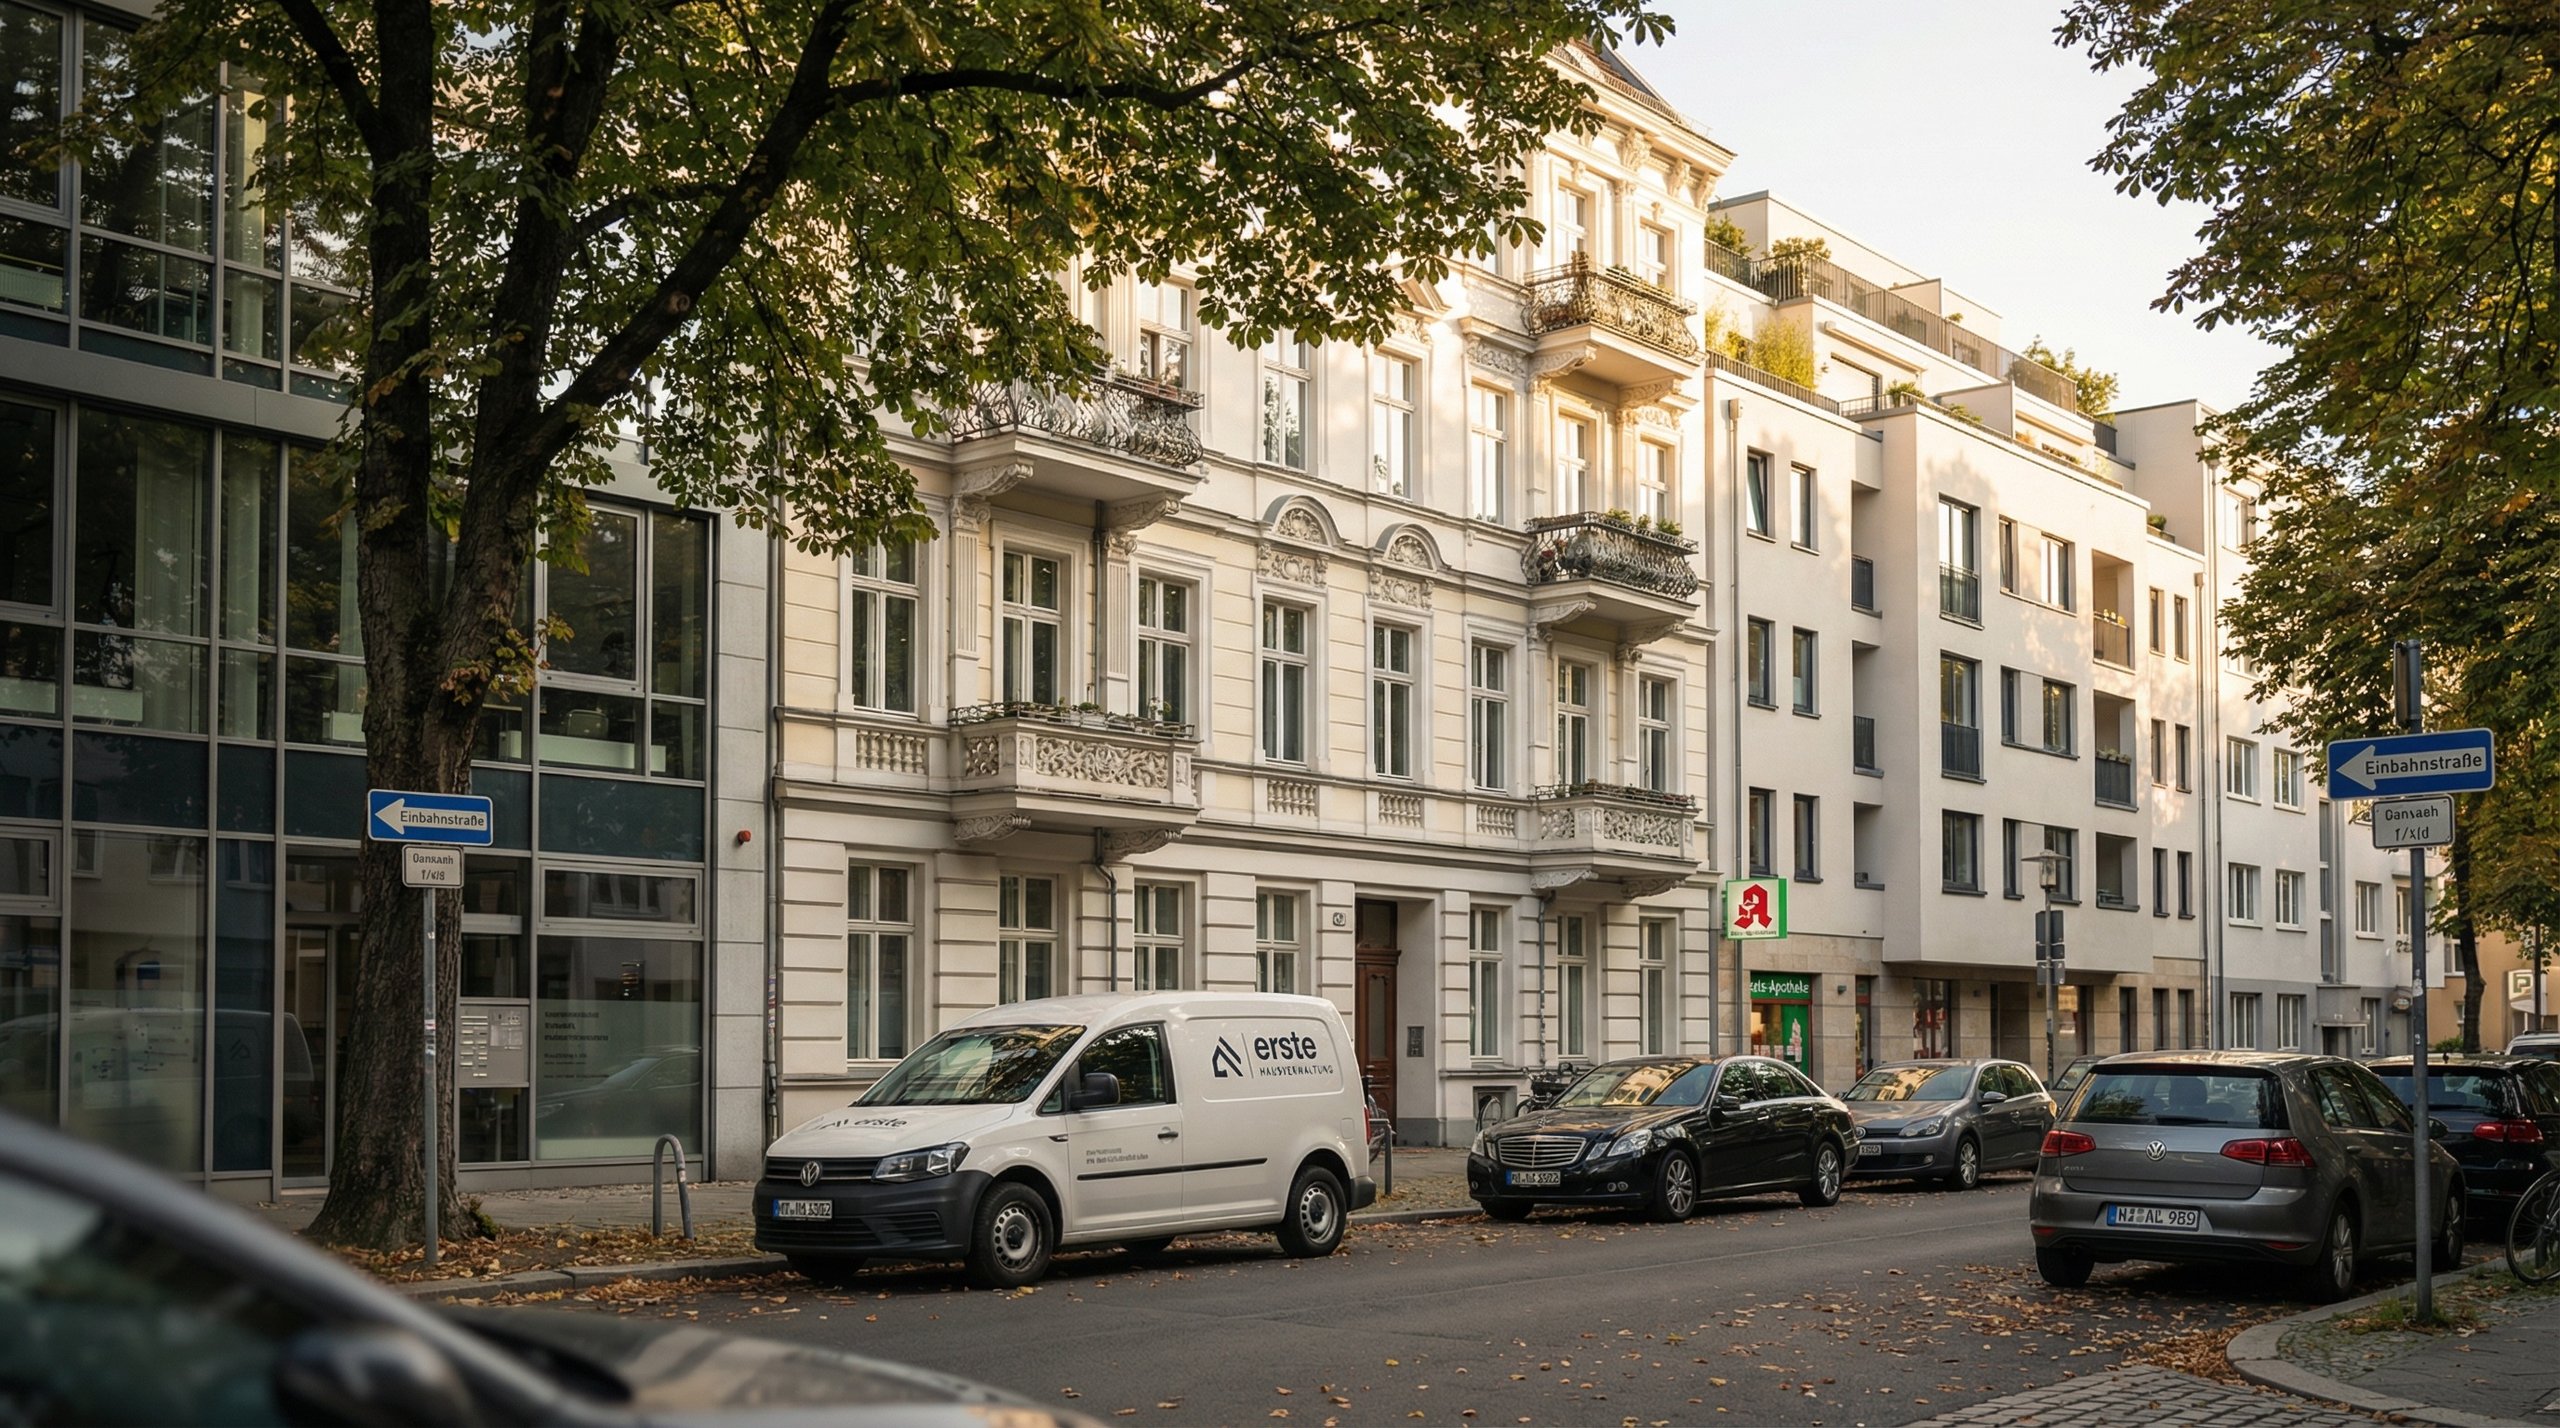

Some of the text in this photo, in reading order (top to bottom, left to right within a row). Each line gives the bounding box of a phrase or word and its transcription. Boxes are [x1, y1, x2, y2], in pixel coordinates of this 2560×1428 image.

[2366, 753, 2482, 775] Einbahnstraße
[400, 811, 484, 827] Einbahnstraße
[1254, 1031, 1317, 1060] erste
